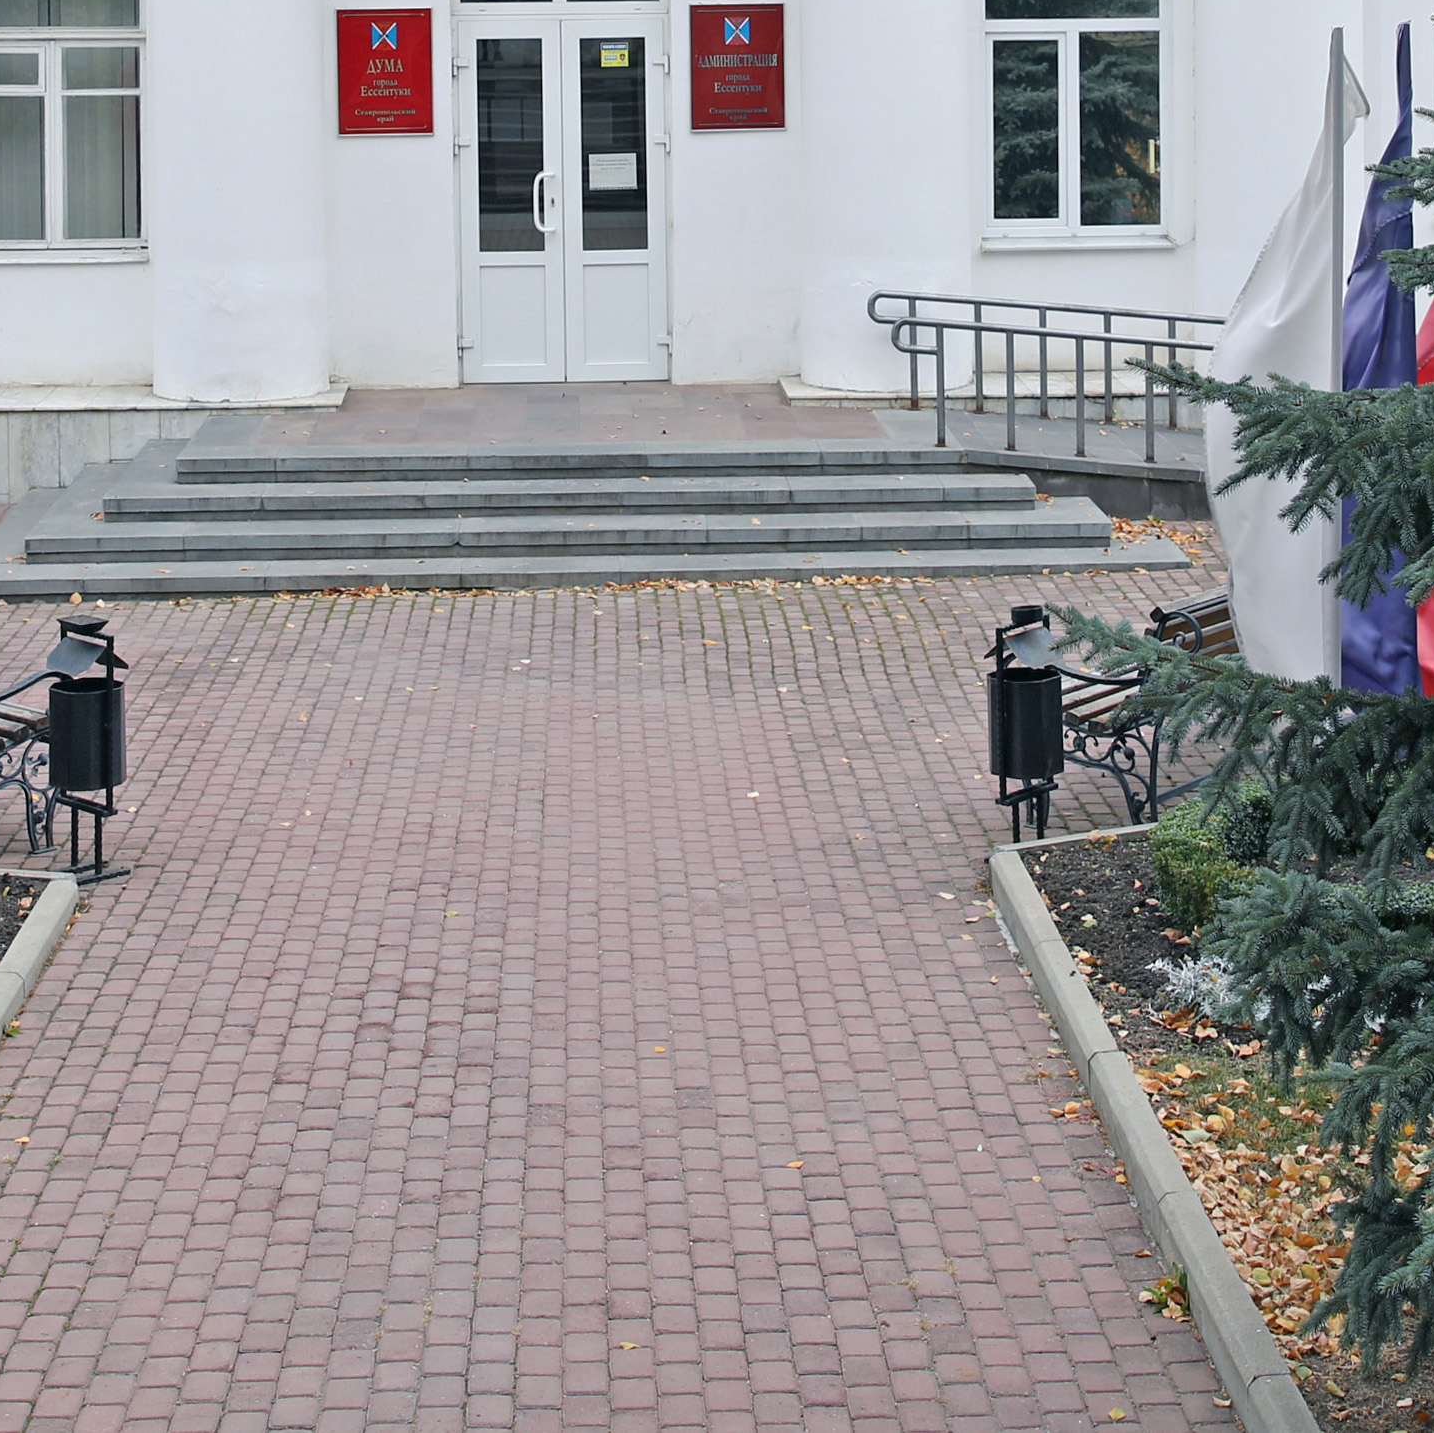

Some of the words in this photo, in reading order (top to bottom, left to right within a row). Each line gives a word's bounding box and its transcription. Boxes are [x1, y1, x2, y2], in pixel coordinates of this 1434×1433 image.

[367, 59, 404, 74] ДУМА
[698, 54, 778, 68] АДМИНИСТРАЦИЯ
[373, 79, 398, 88] города
[725, 74, 750, 83] города
[361, 86, 411, 99] Ессентуки
[714, 82, 762, 95] Ессентуки
[355, 109, 416, 117] Ставропольский
